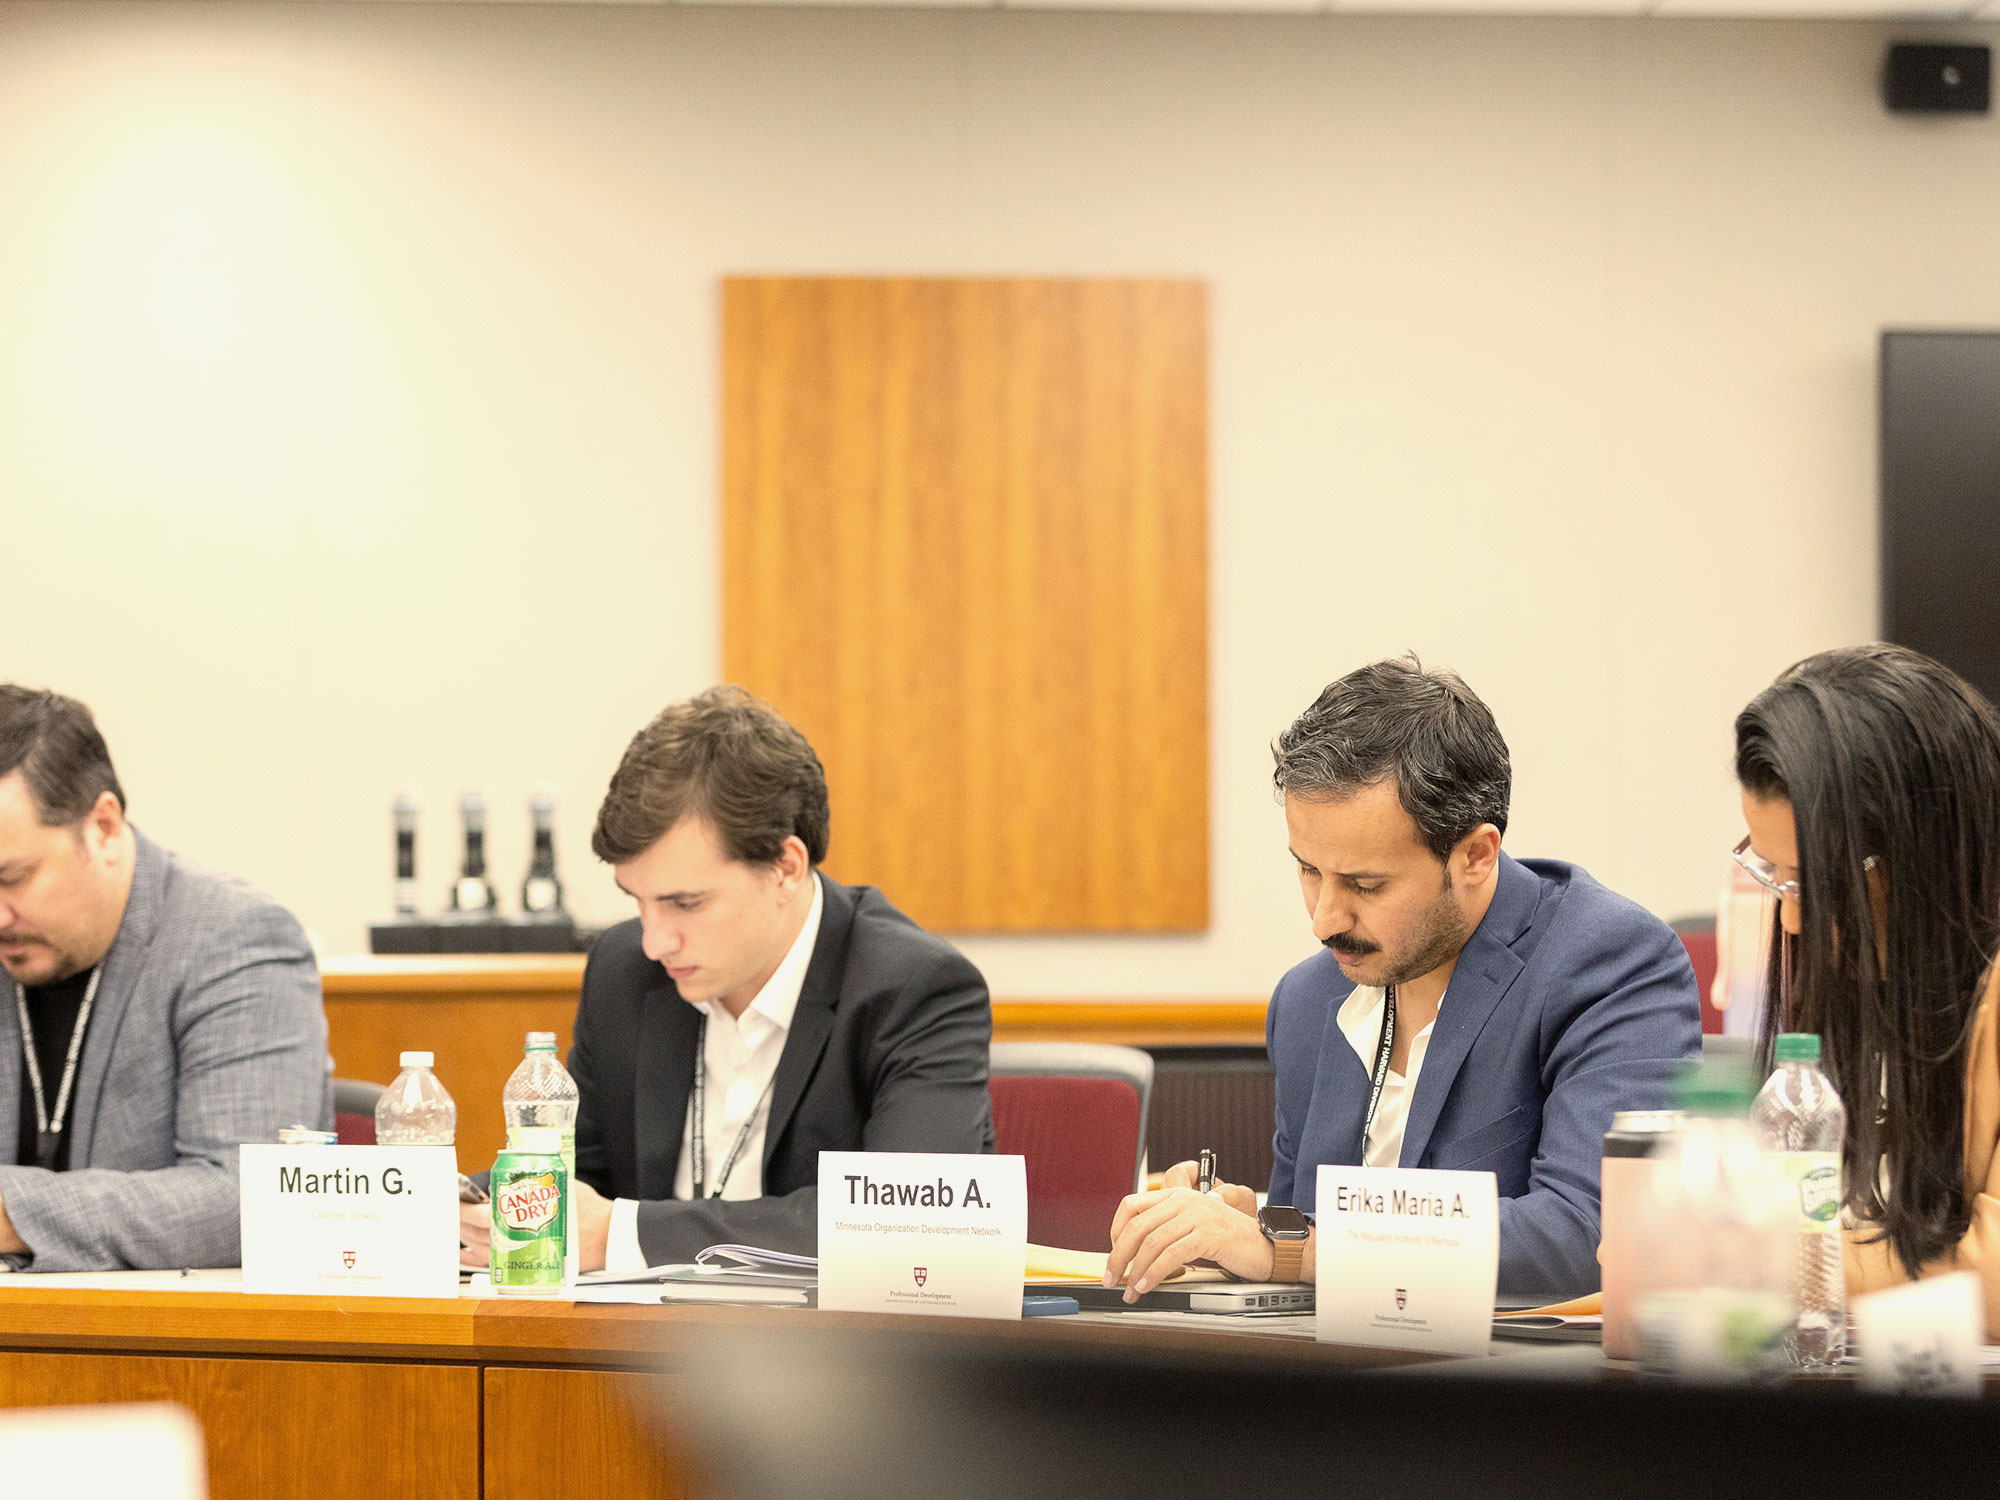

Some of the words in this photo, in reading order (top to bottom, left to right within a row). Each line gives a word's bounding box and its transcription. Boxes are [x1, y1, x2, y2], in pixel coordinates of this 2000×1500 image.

[1384, 984, 1396, 1046] DEVELOPMENT
[1374, 1046, 1391, 1087] HARVARD
[279, 1166, 370, 1195] Martin
[382, 1167, 413, 1195] G.
[844, 1175, 954, 1208] Thawab
[962, 1178, 991, 1209] A.
[497, 1184, 561, 1215] CANADA
[515, 1202, 549, 1222] DRY
[1337, 1186, 1385, 1214] Erika
[1391, 1189, 1444, 1217] Maria
[1450, 1192, 1470, 1219] A.
[835, 1221, 873, 1232] Minnesota
[874, 1222, 920, 1235] Organization
[921, 1224, 970, 1237] Development
[971, 1226, 1002, 1236] Network
[504, 1261, 544, 1270] GINGER
[920, 1291, 952, 1300] Development
